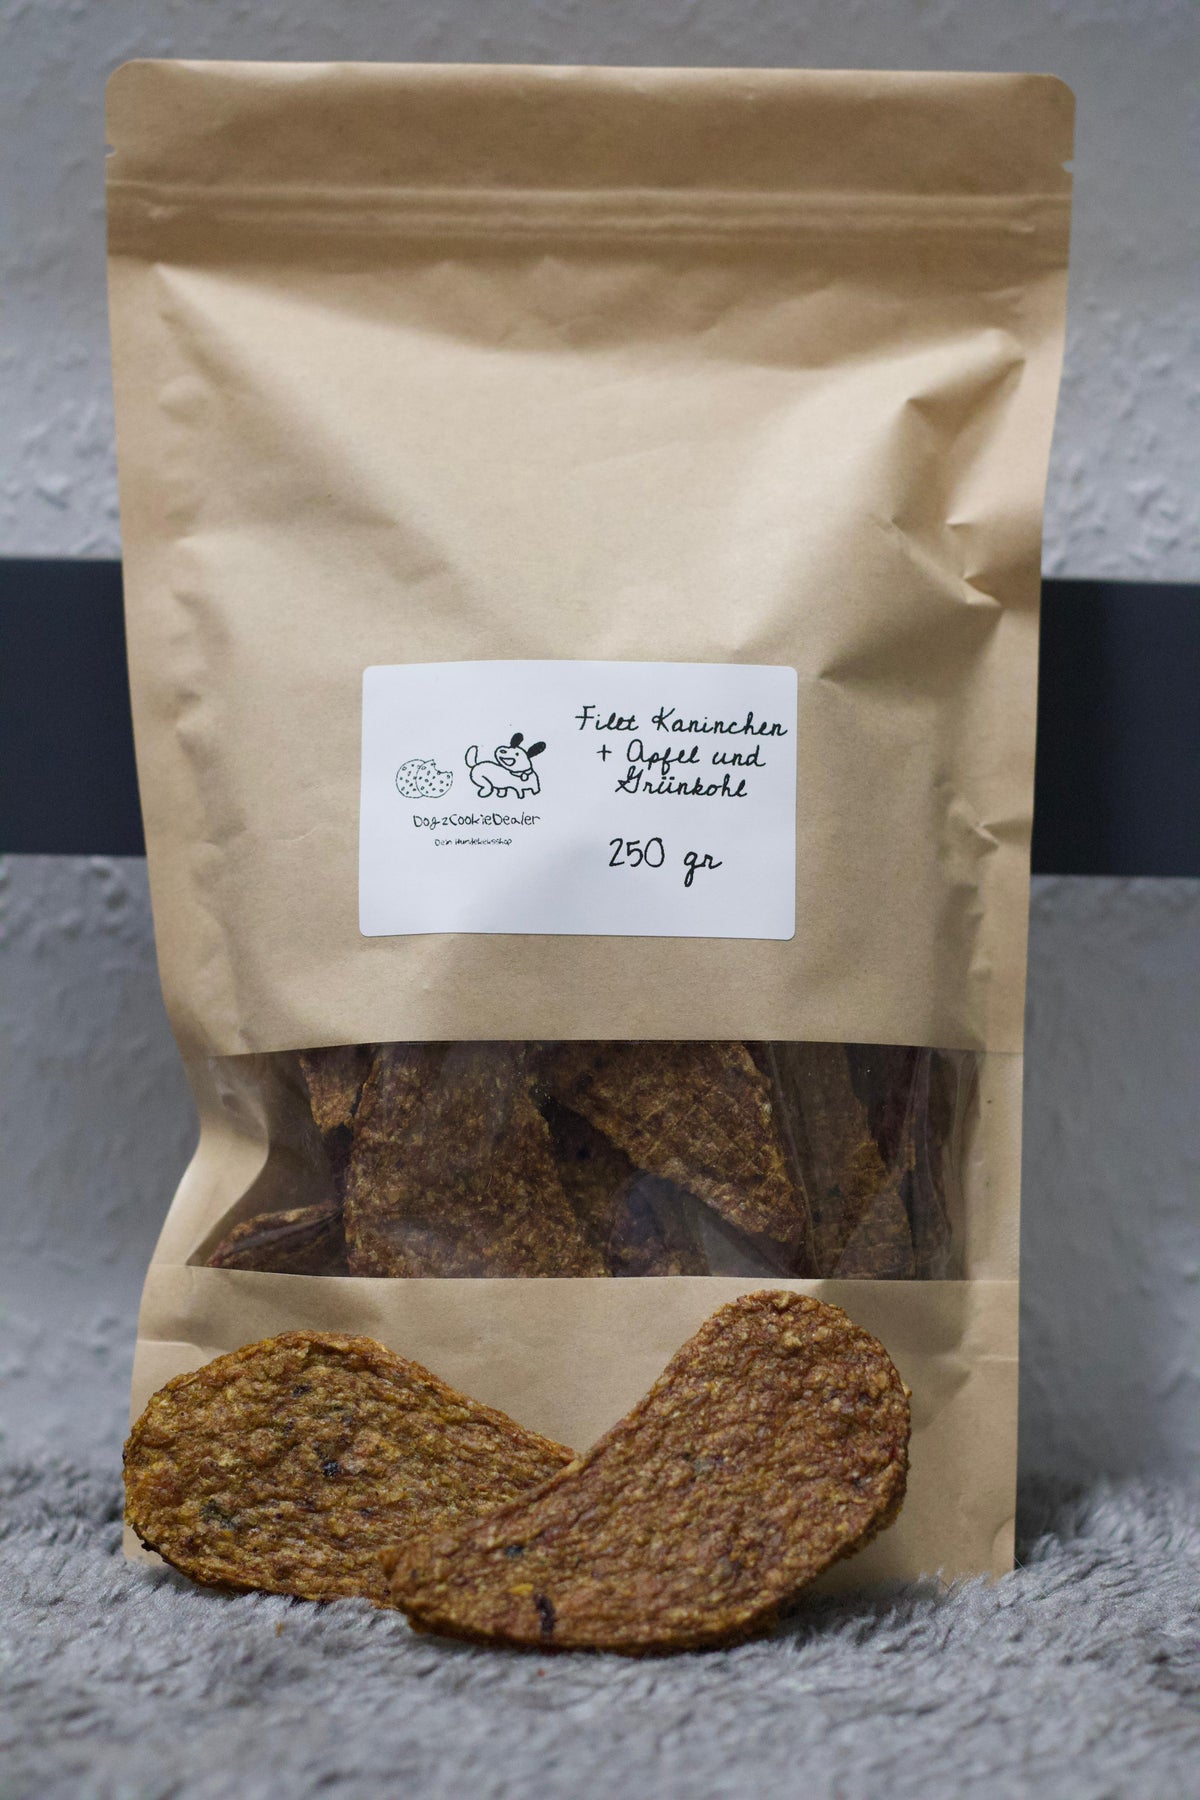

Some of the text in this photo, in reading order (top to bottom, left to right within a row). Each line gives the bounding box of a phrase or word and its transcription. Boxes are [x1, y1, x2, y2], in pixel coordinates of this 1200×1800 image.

[575, 704, 788, 737] Filet Kaninchen
[596, 738, 767, 776] + Apfel und
[614, 765, 748, 798] Grünkohl
[608, 837, 723, 888] 250 gr
